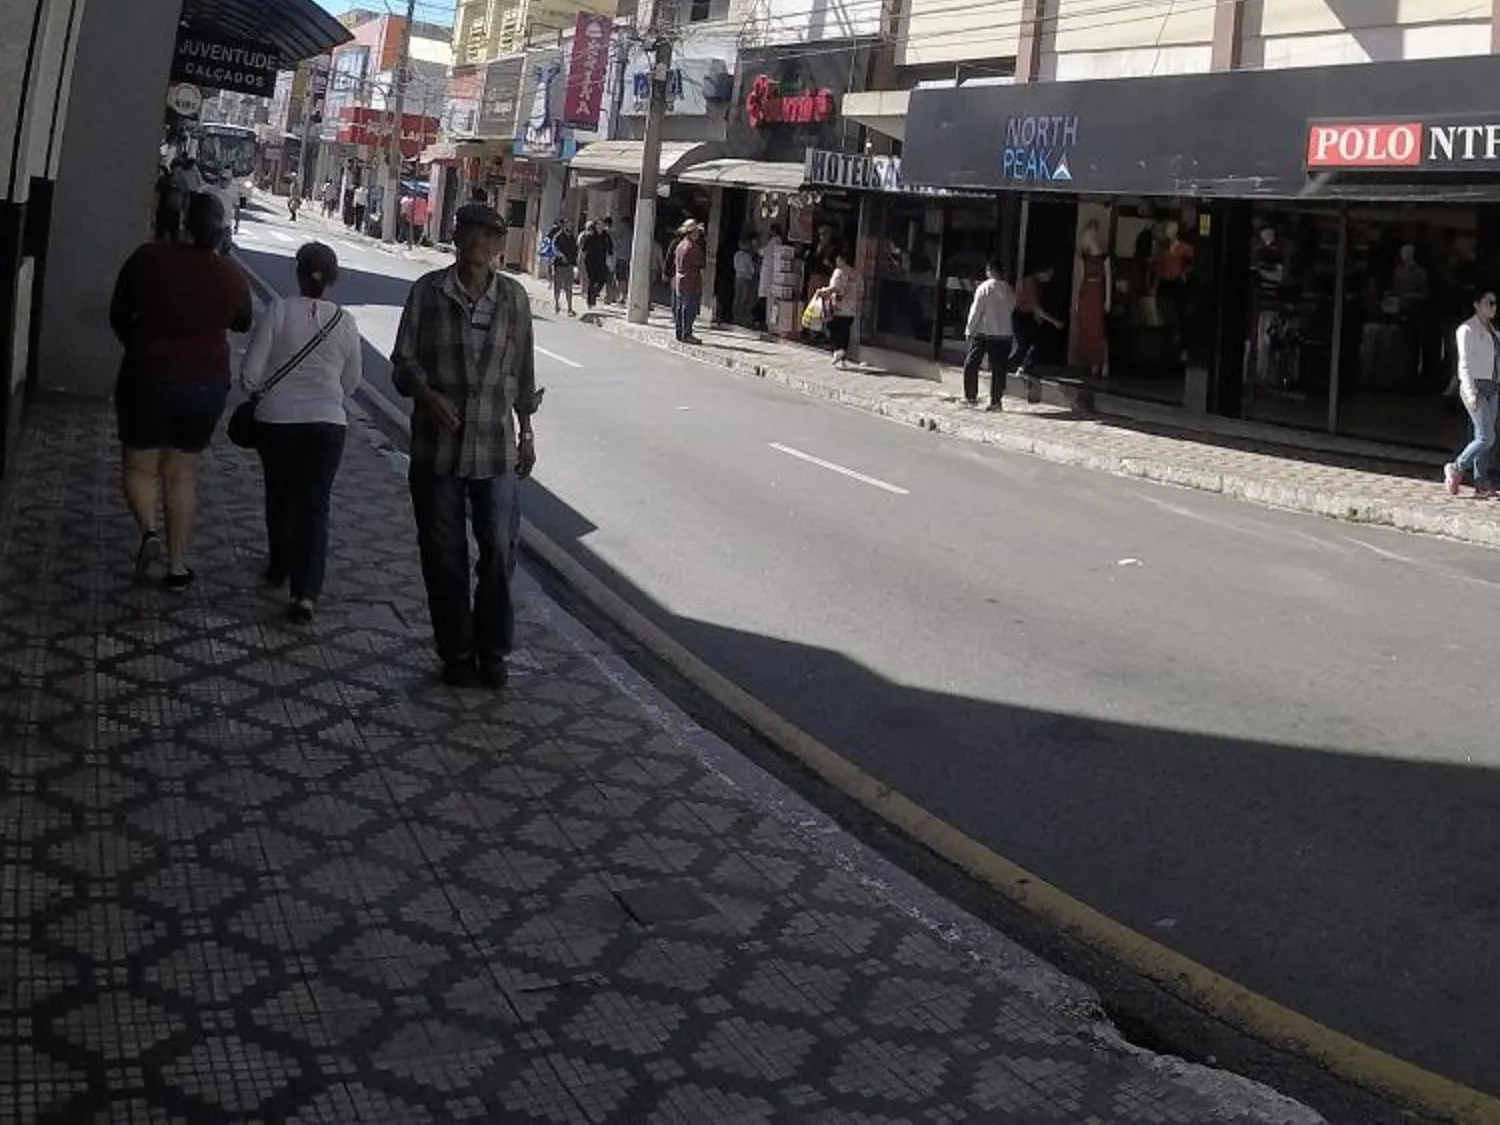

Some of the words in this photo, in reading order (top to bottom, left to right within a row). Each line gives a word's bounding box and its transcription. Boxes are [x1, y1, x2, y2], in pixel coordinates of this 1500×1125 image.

[179, 39, 278, 71] JUVENTUDE
[1006, 115, 1079, 147] NORTH
[1314, 127, 1415, 161] POLO
[811, 152, 871, 188] HOTEL
[1003, 148, 1051, 180] PEAK
